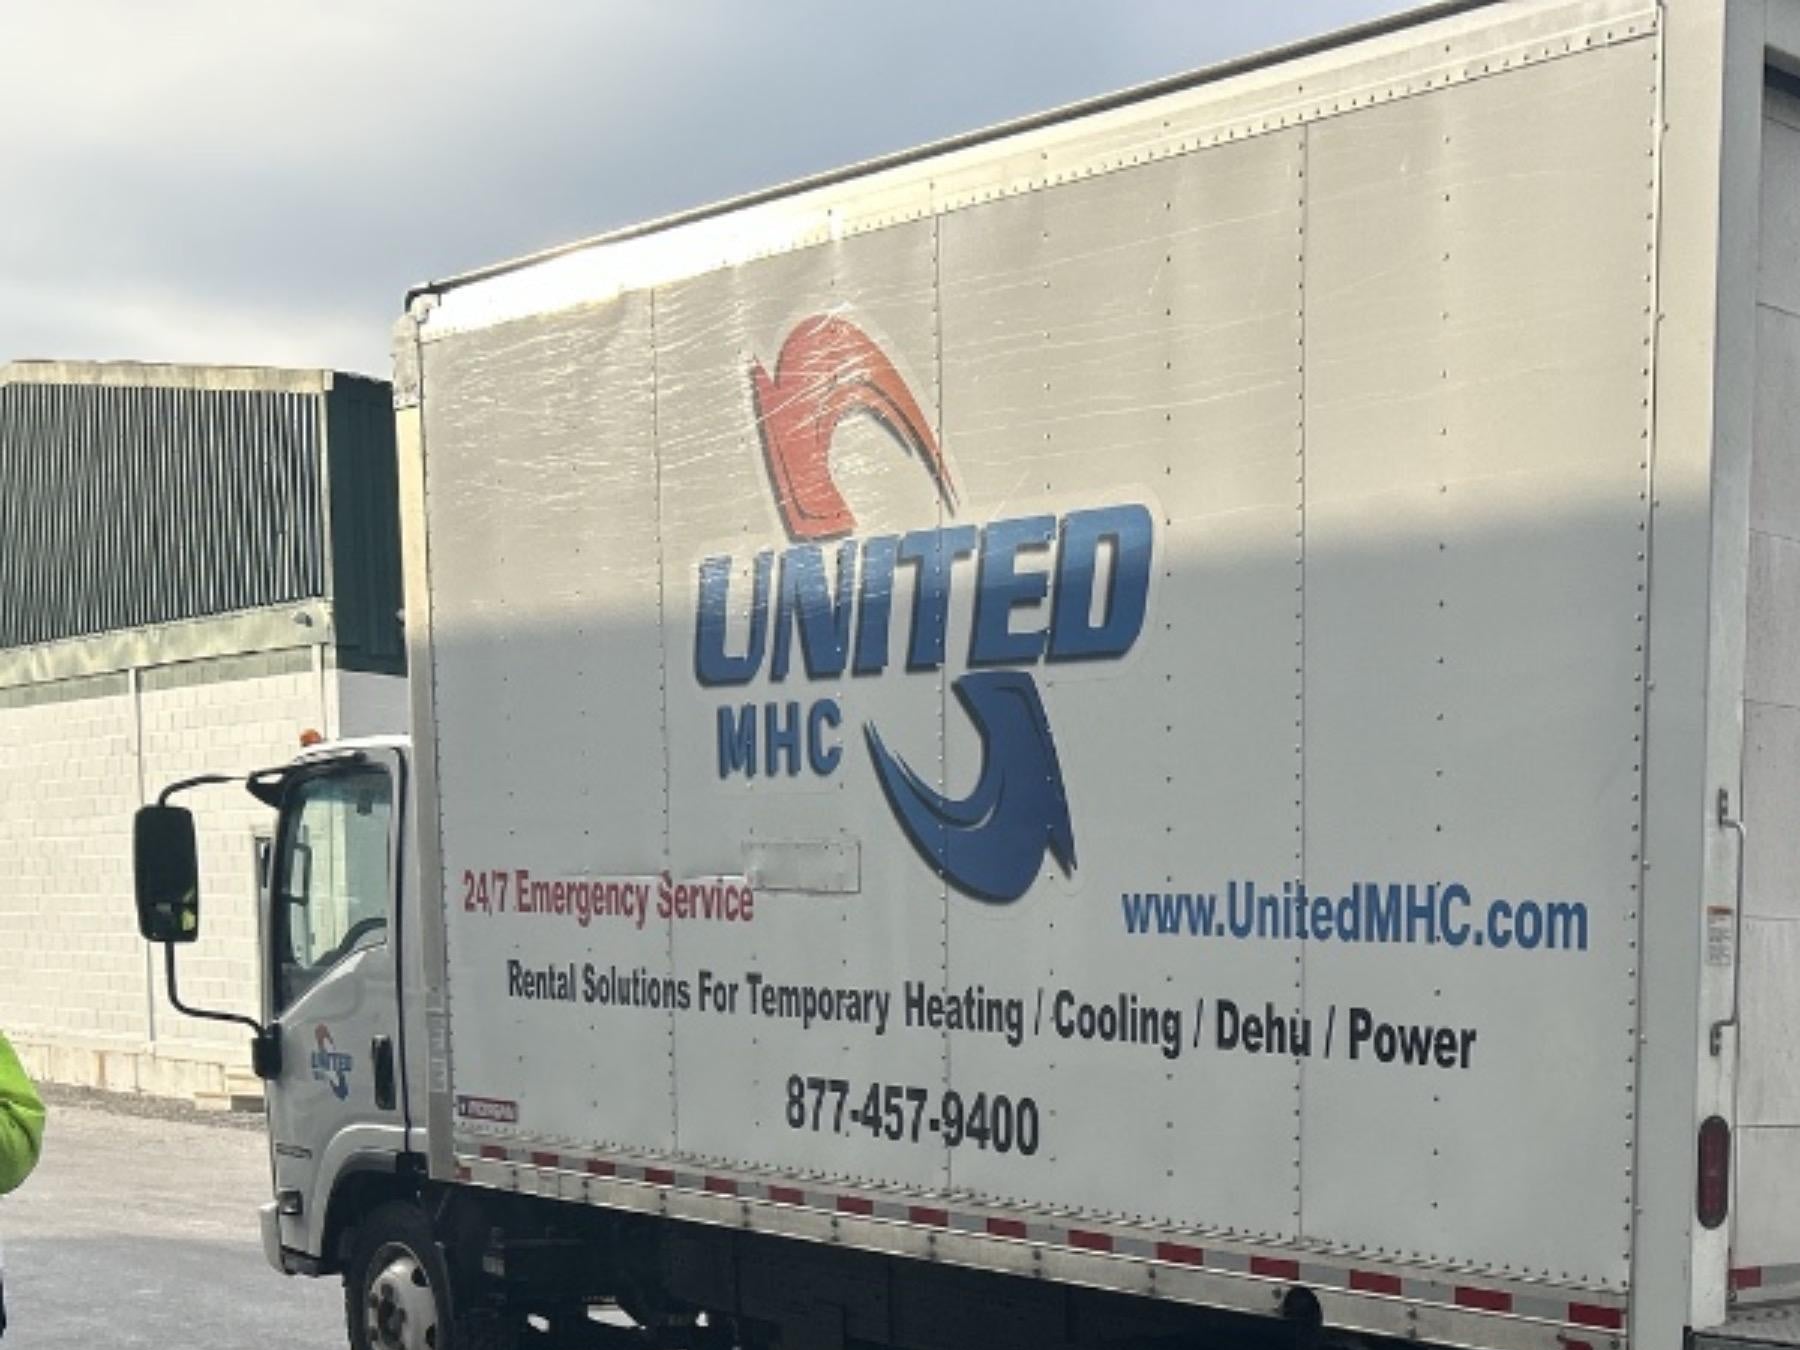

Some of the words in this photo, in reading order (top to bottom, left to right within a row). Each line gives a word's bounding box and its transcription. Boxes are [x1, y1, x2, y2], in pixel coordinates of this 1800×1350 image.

[695, 503, 1154, 687] UNITED
[716, 697, 843, 781] MHC
[463, 869, 509, 917] 24/7
[516, 869, 651, 930] Emergency
[656, 872, 755, 922] Service
[1121, 881, 1590, 951] www.UnitedMHC.com
[507, 958, 577, 1003] Rental
[581, 962, 691, 1011] Solutions
[698, 969, 740, 1015] For
[746, 971, 890, 1036] Temporary
[903, 980, 1024, 1048] Heating
[1054, 990, 1183, 1059] Cooling
[1193, 998, 1205, 1048] /
[1215, 998, 1312, 1057] Dehu
[1323, 1005, 1337, 1059] /
[1348, 1007, 1478, 1070] Power
[785, 1074, 1040, 1157] 877-457-9400
